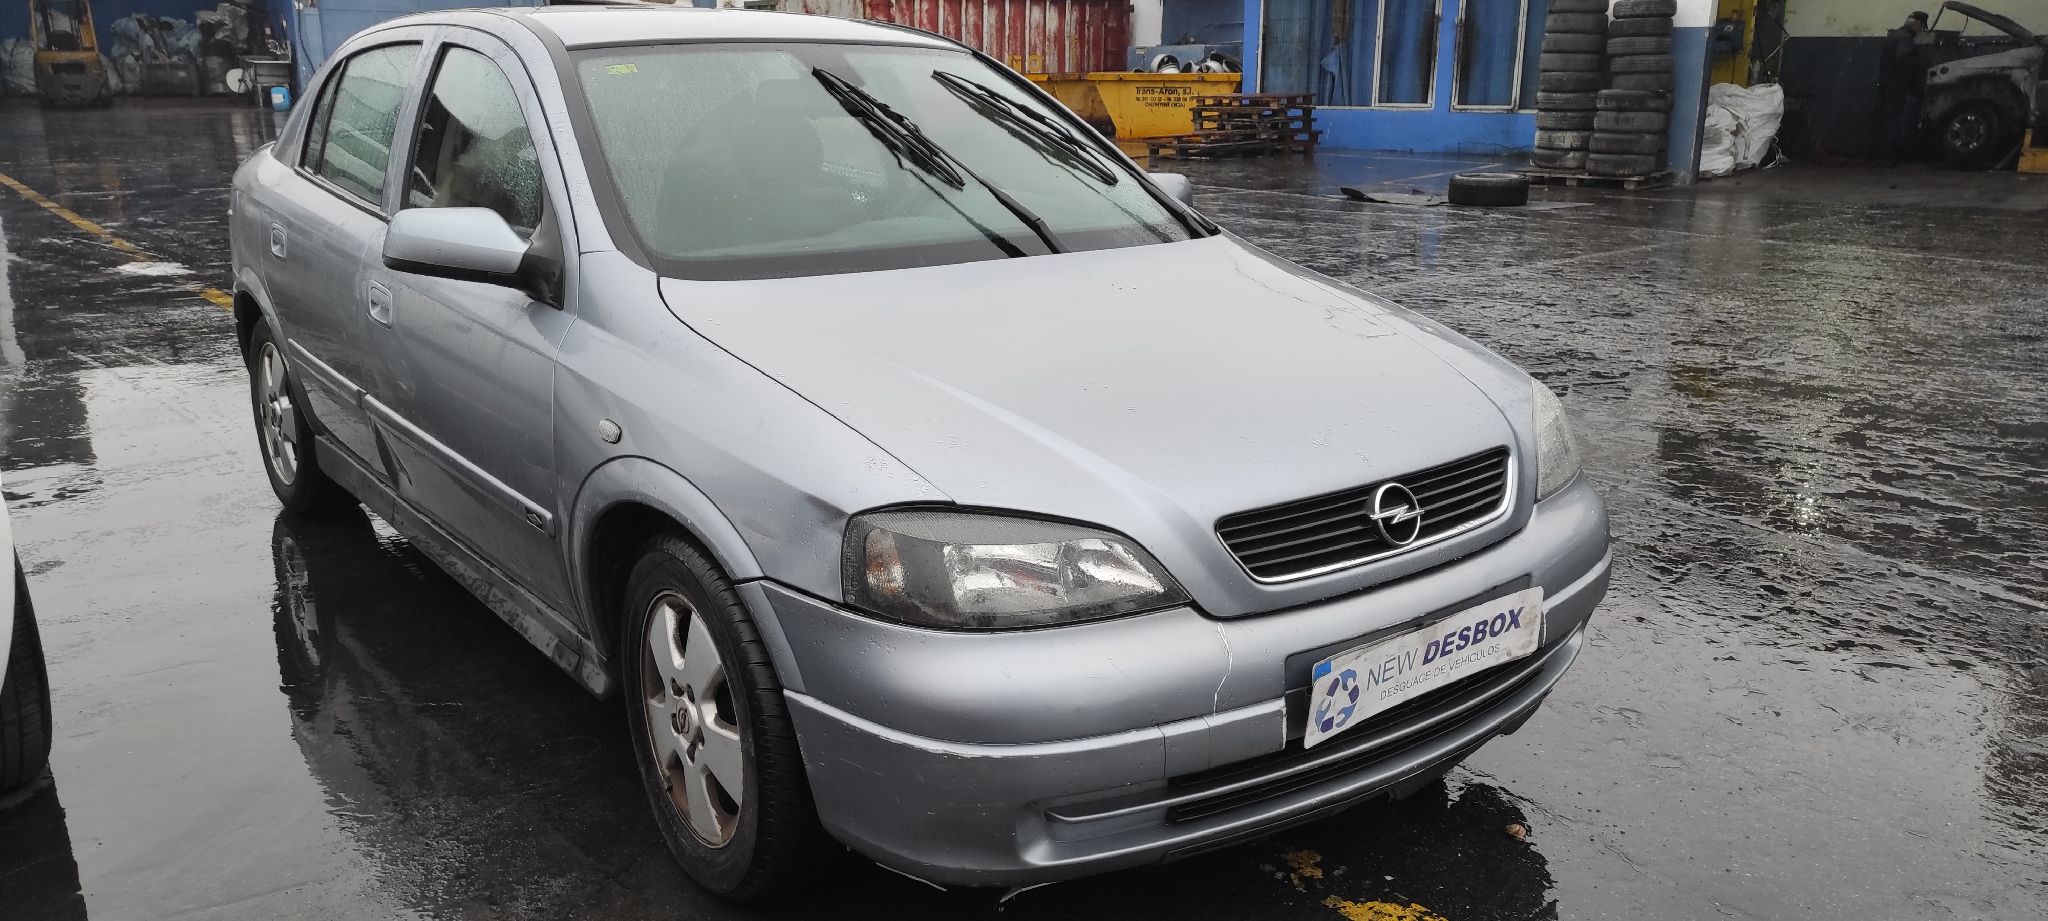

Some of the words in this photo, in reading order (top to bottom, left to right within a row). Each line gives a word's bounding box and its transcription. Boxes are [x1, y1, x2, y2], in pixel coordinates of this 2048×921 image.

[1366, 648, 1418, 691] NEW
[1422, 606, 1525, 666] DESBOX
[1380, 671, 1431, 701] DESGUACE
[1433, 664, 1446, 677] DE
